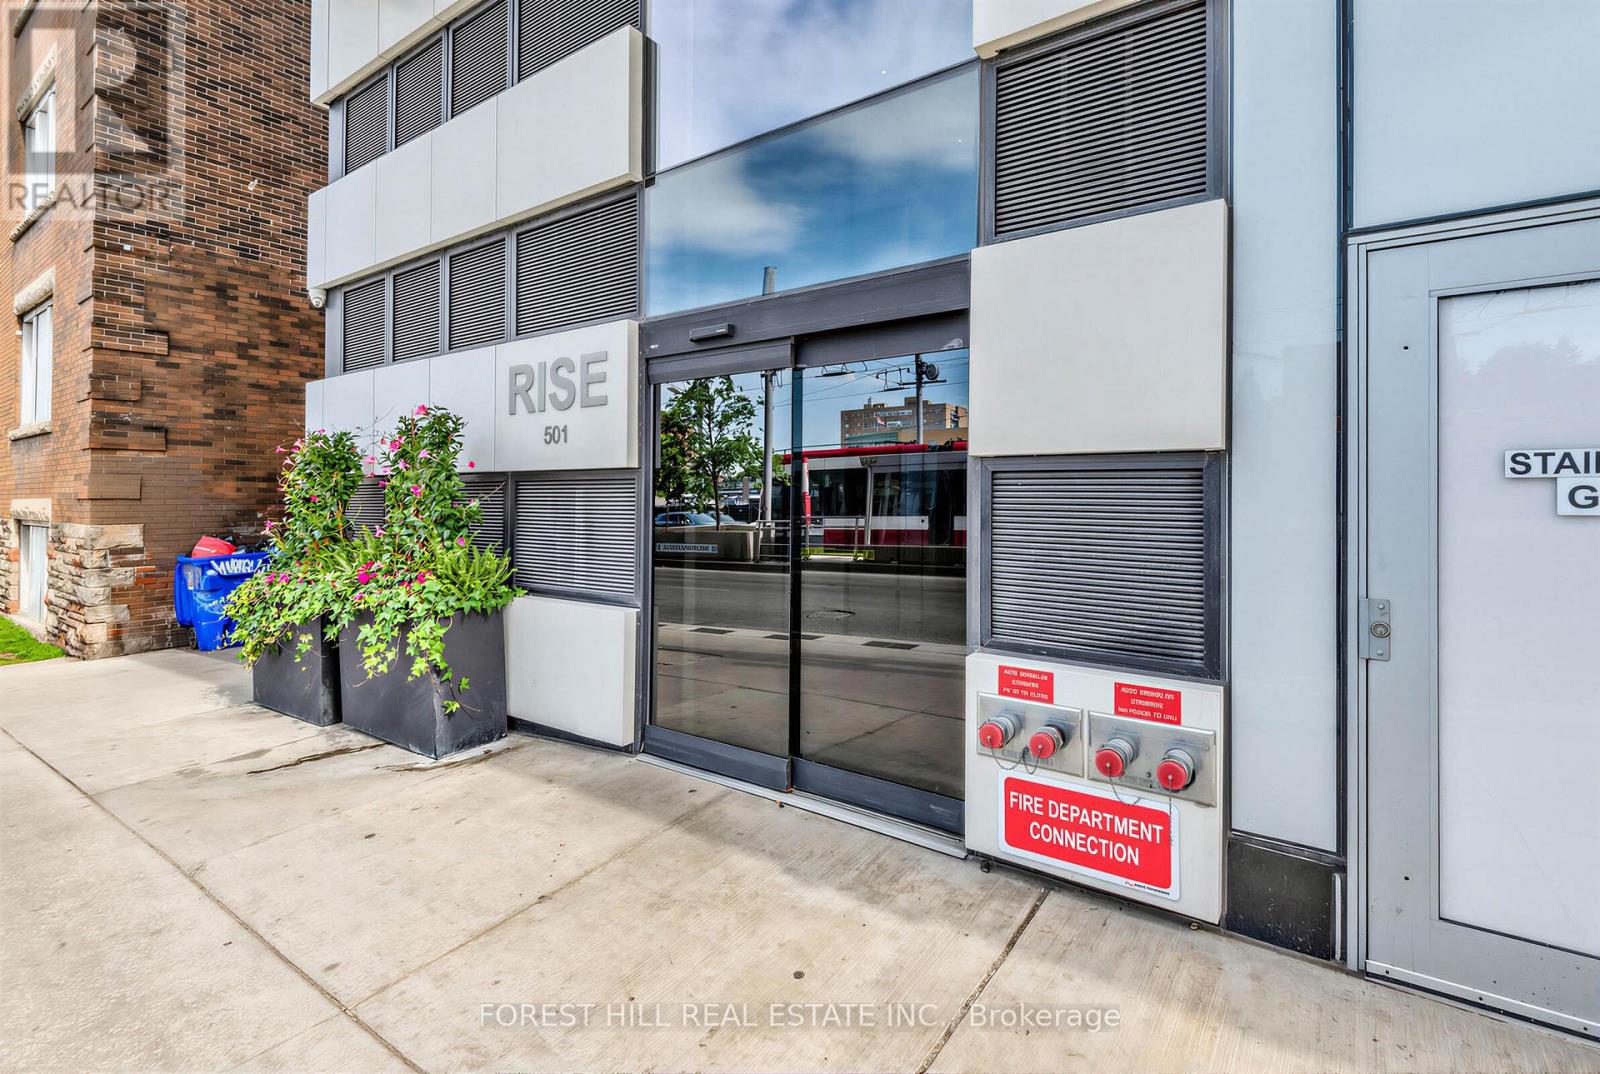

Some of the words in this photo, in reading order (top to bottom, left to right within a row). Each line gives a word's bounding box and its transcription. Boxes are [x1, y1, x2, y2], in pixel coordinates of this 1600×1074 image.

[508, 351, 608, 416] RISE
[544, 425, 568, 445] 501
[1509, 451, 1600, 475] STAI
[1009, 791, 1044, 816] FIRE
[1048, 800, 1163, 844] DEPARTMENT
[1029, 821, 1140, 866] CONNECTION
